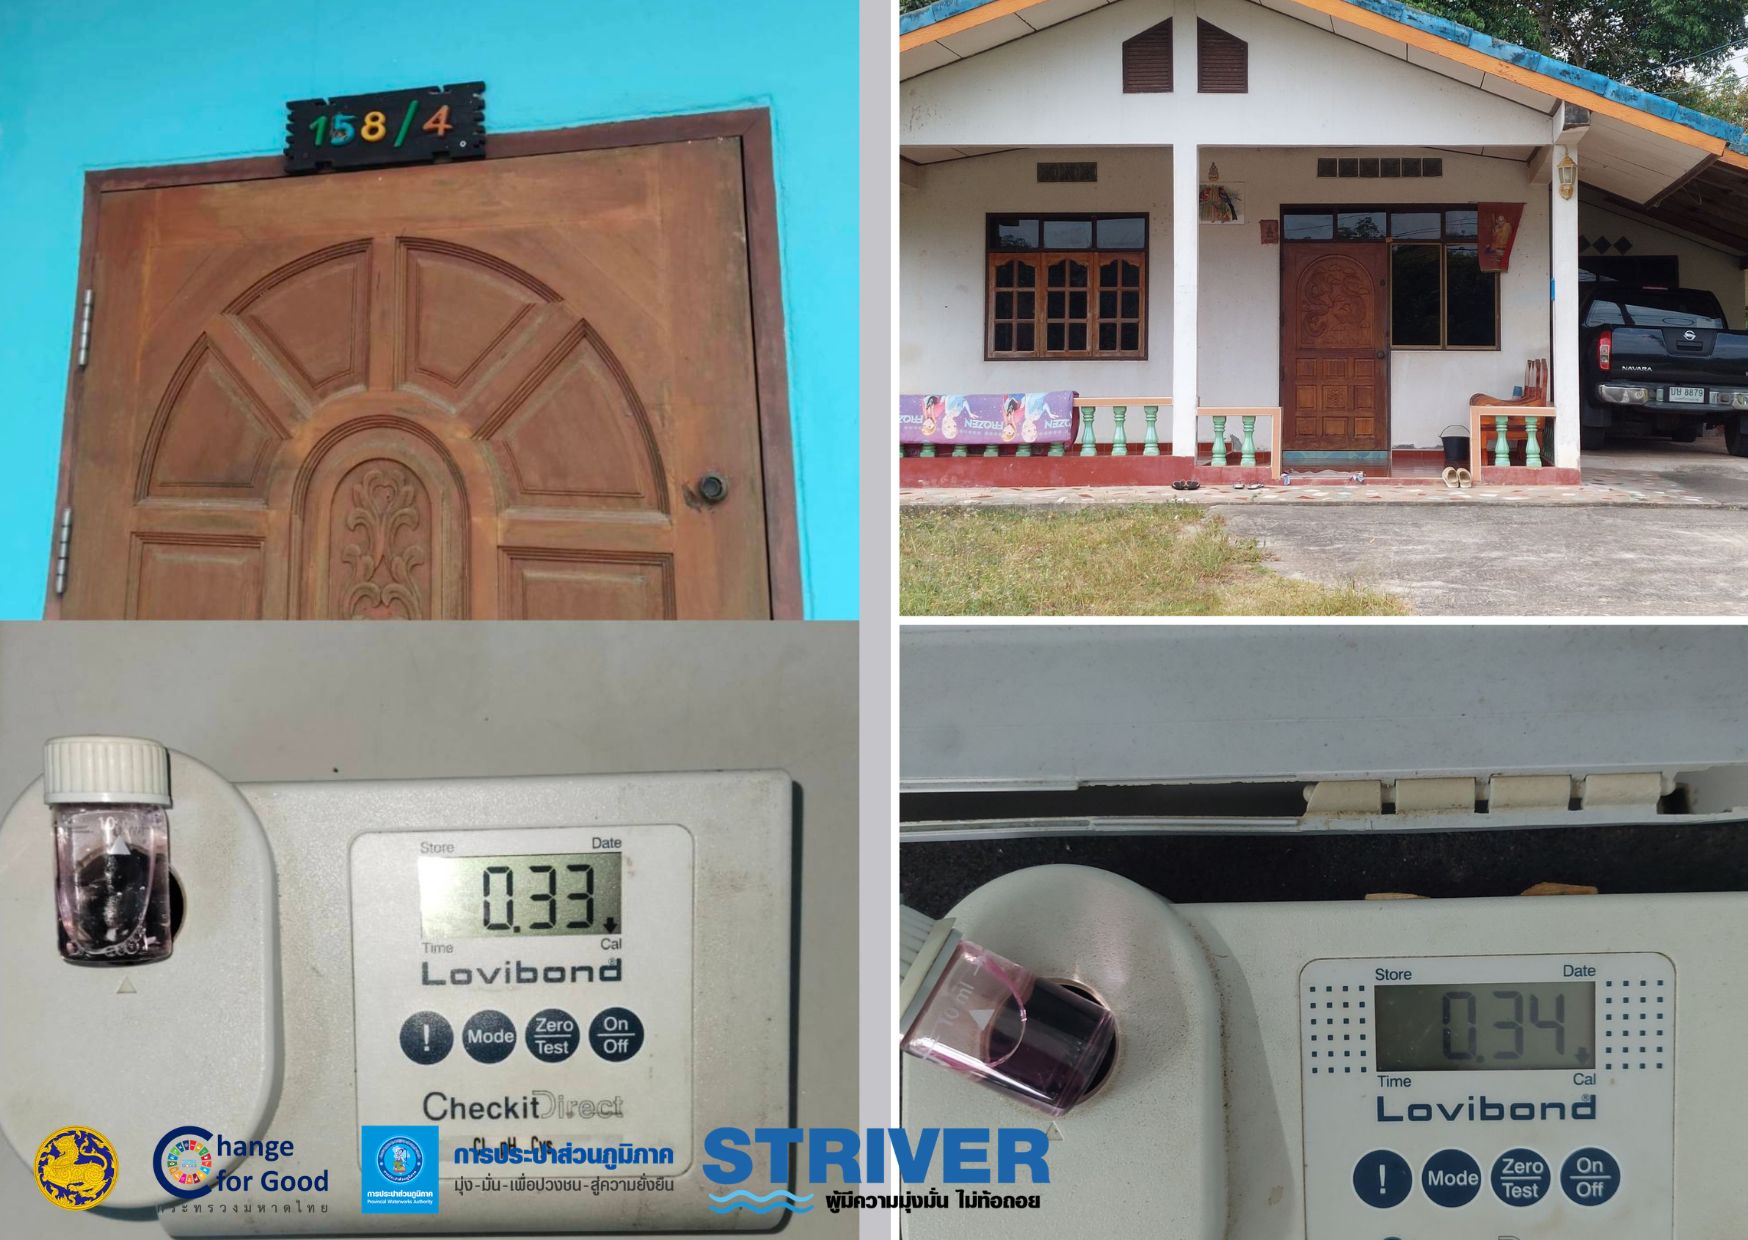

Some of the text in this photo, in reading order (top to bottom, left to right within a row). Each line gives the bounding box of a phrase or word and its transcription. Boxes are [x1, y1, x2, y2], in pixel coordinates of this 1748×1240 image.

[309, 100, 453, 147] 158/4
[1621, 365, 1653, 373] NAVARA
[964, 418, 1004, 431] FROZEN
[420, 837, 622, 854] Store Date
[483, 863, 595, 933] 0.33
[422, 937, 622, 954] Time Cal
[1375, 964, 1596, 981] Store Date
[535, 1017, 574, 1032] Zero
[603, 1016, 629, 1031] On
[1442, 990, 1565, 1064] 0.34
[468, 1029, 515, 1044] Mode
[535, 1039, 569, 1054] Test
[603, 1038, 629, 1054] Off
[1377, 1072, 1597, 1088] Time Cal
[1502, 1158, 1544, 1175] Zero
[1576, 1157, 1604, 1173] On
[1428, 1170, 1480, 1186] Mode
[1502, 1181, 1539, 1199] Test
[1576, 1181, 1604, 1198] Off
